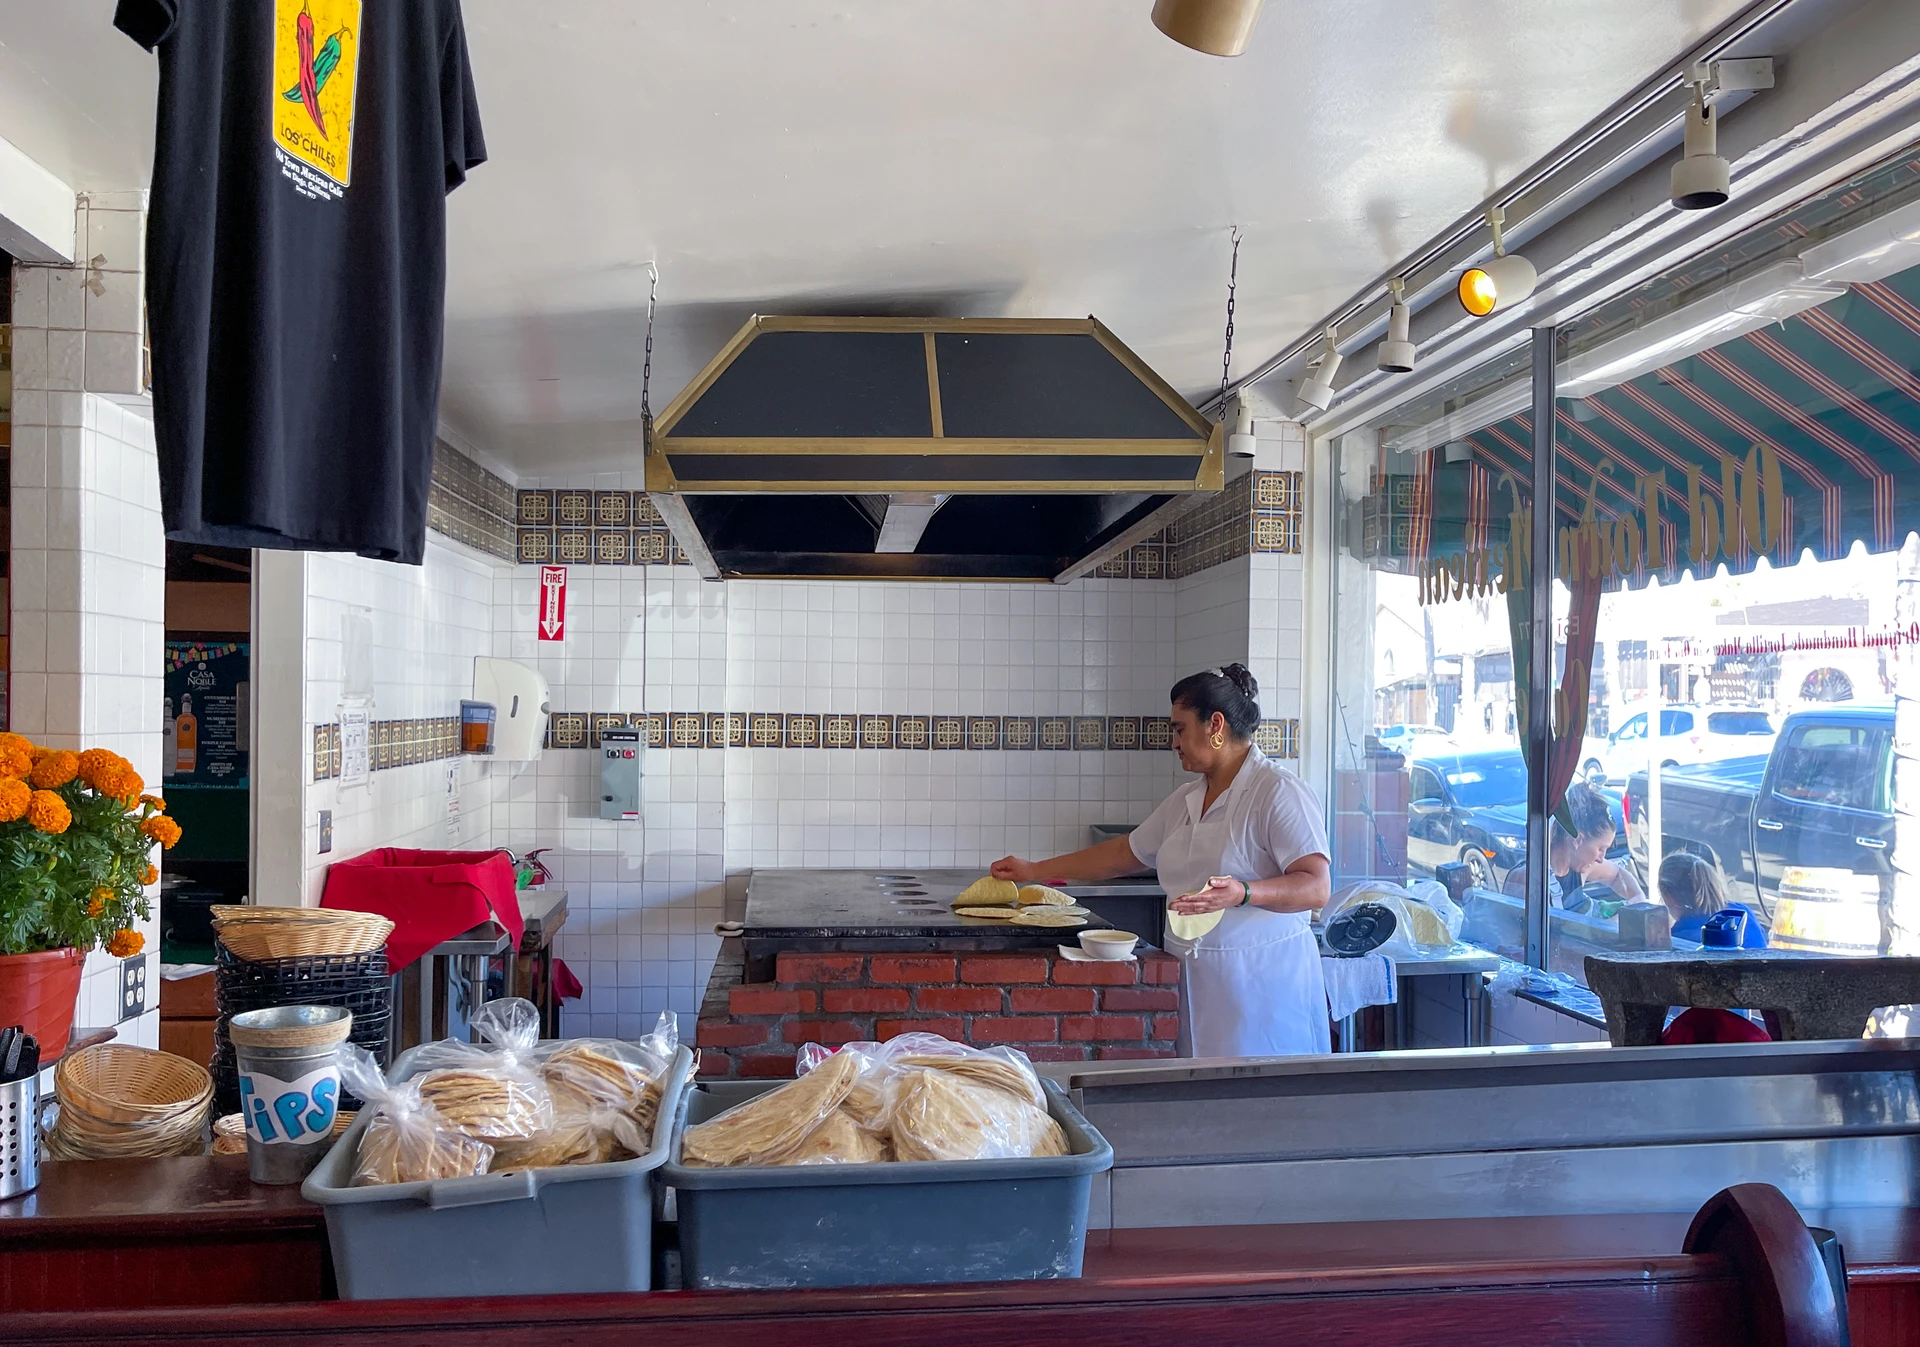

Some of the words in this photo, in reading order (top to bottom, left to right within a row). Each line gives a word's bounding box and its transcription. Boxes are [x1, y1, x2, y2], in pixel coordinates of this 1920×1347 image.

[281, 123, 299, 145] LOS
[302, 138, 336, 168] CHILES
[275, 147, 284, 163] Old
[284, 155, 300, 173] Town
[301, 165, 328, 189] Mexican
[329, 182, 344, 198] Cafe
[282, 166, 292, 178] San
[308, 181, 331, 201] California
[545, 573, 563, 583] FIRE
[187, 677, 217, 685] NOBLE
[189, 670, 214, 678] CASA
